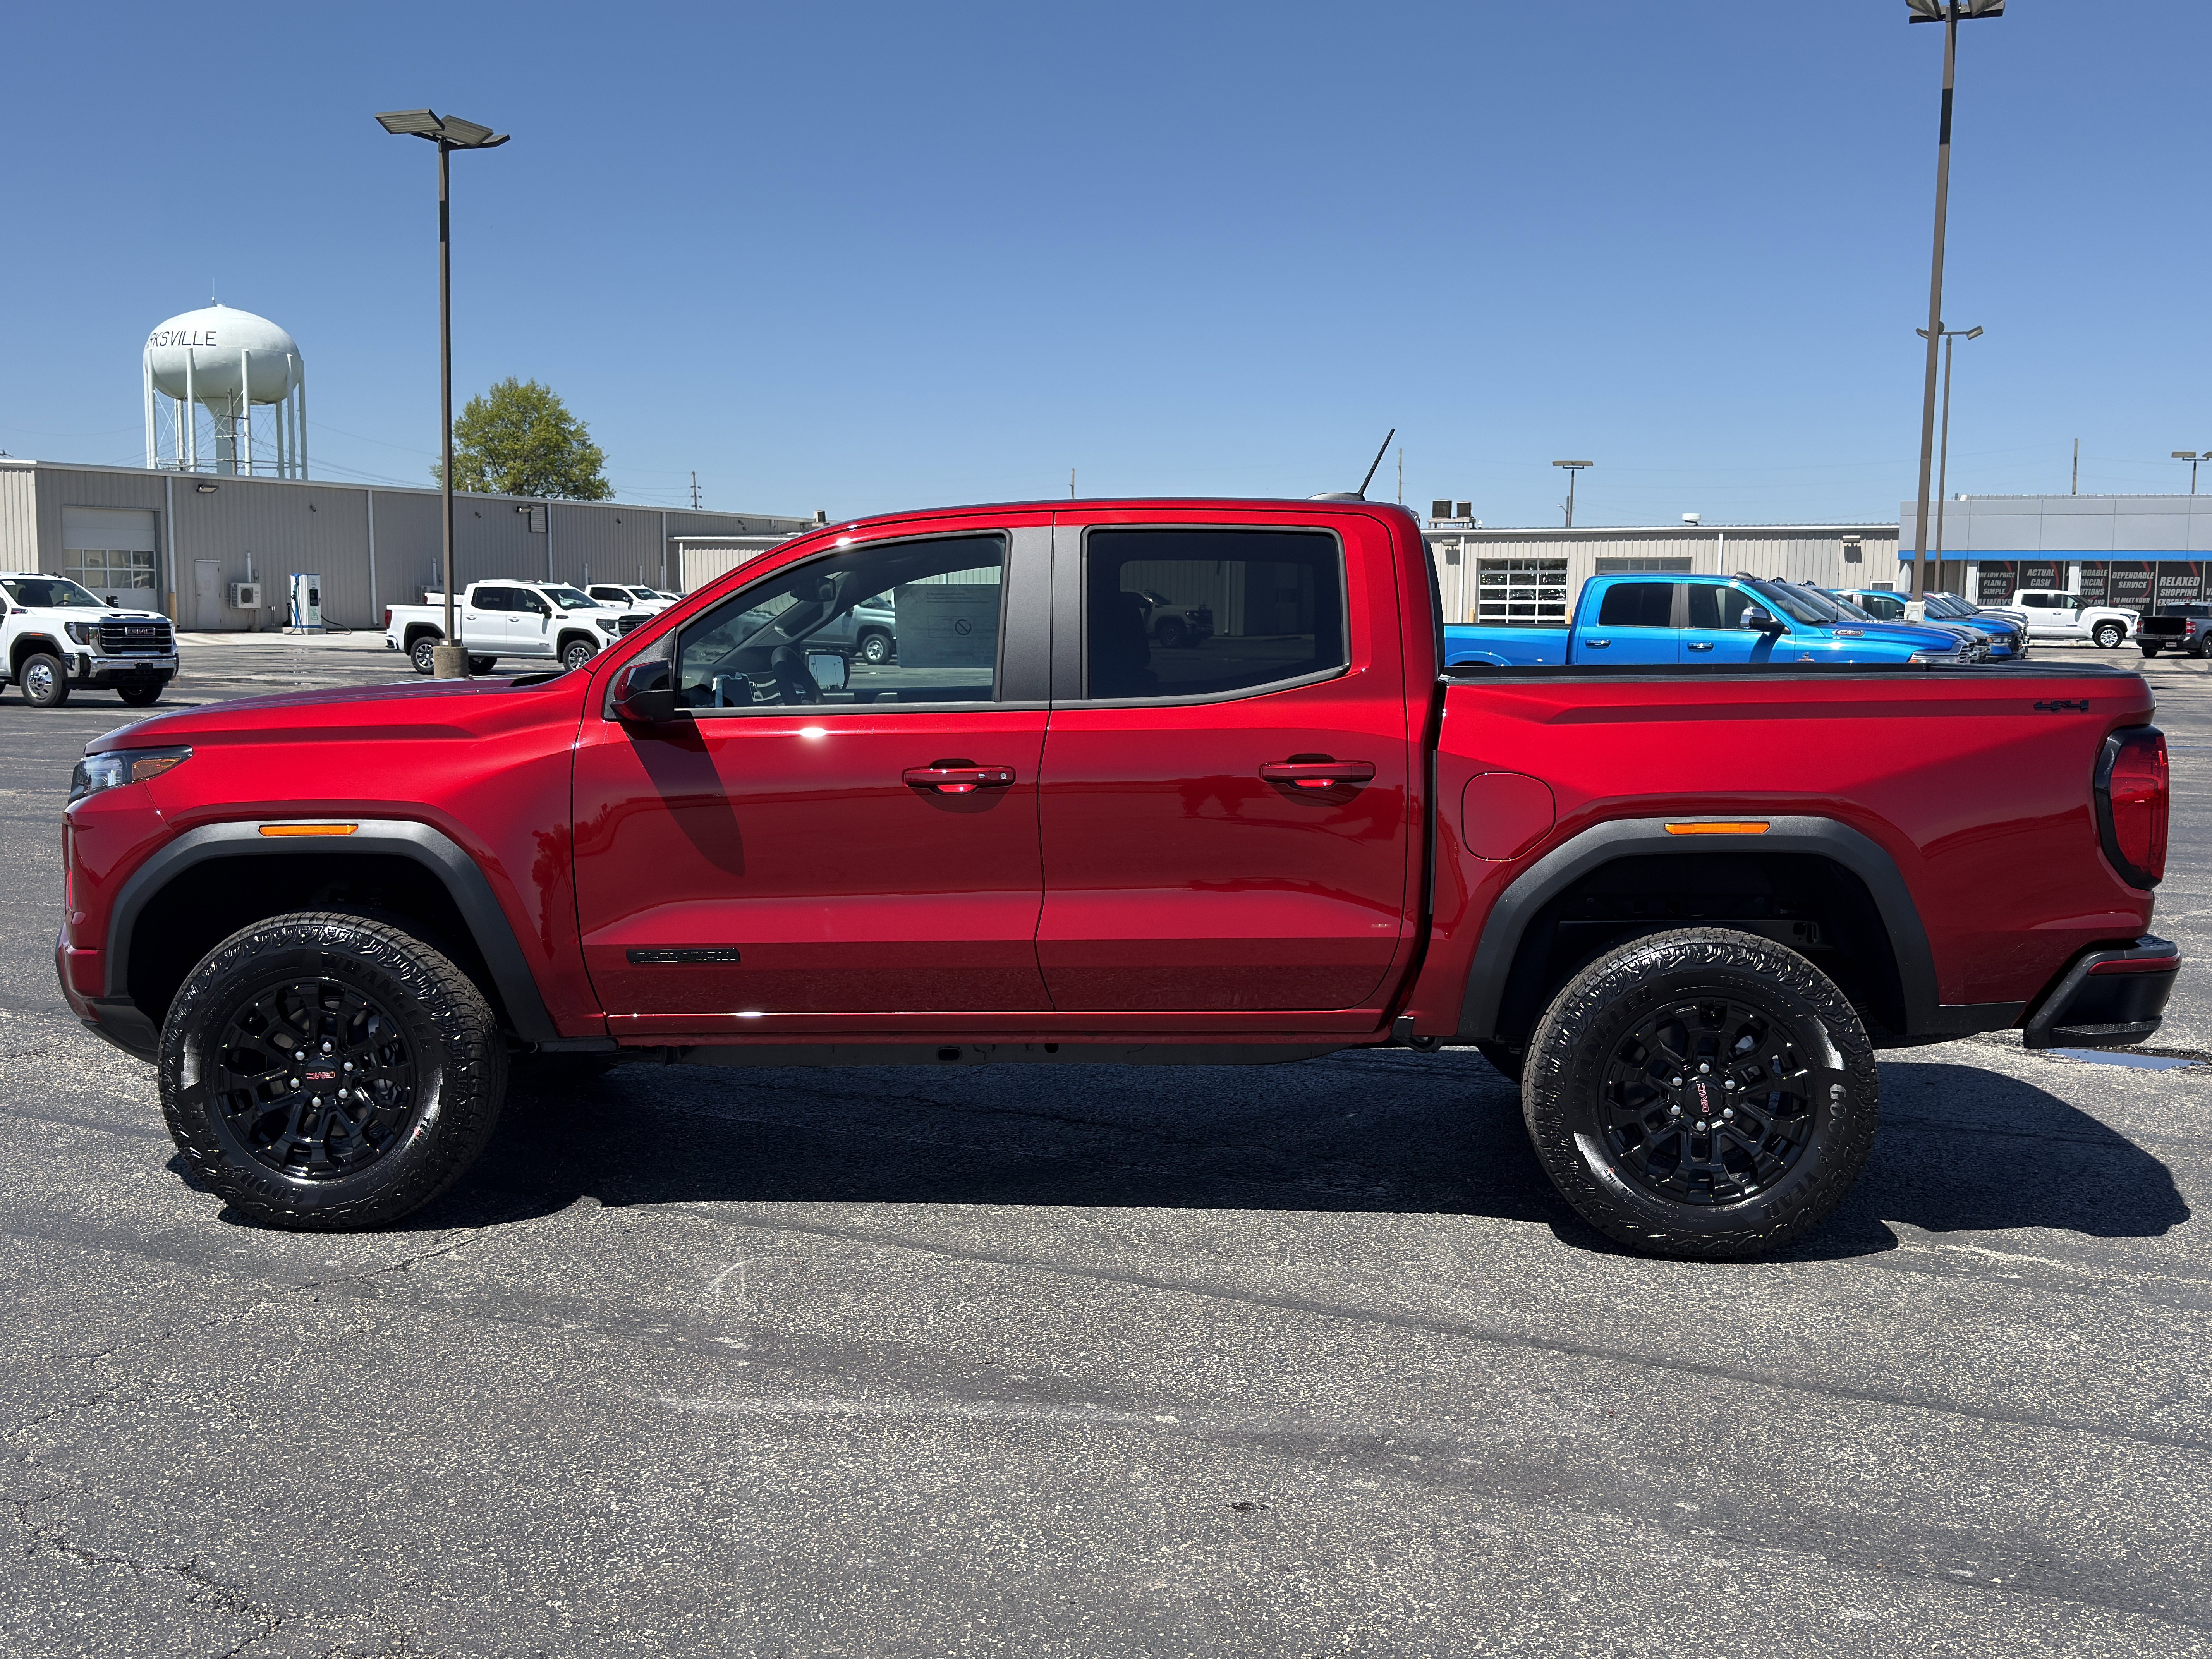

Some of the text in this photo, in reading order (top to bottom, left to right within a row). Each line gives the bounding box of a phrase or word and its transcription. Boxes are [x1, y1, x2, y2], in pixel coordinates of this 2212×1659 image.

[2159, 576, 2200, 586] RELAXED
[2160, 588, 2198, 596] SHOPPING
[306, 1071, 335, 1080] GMC
[1697, 1083, 1709, 1113] GMC
